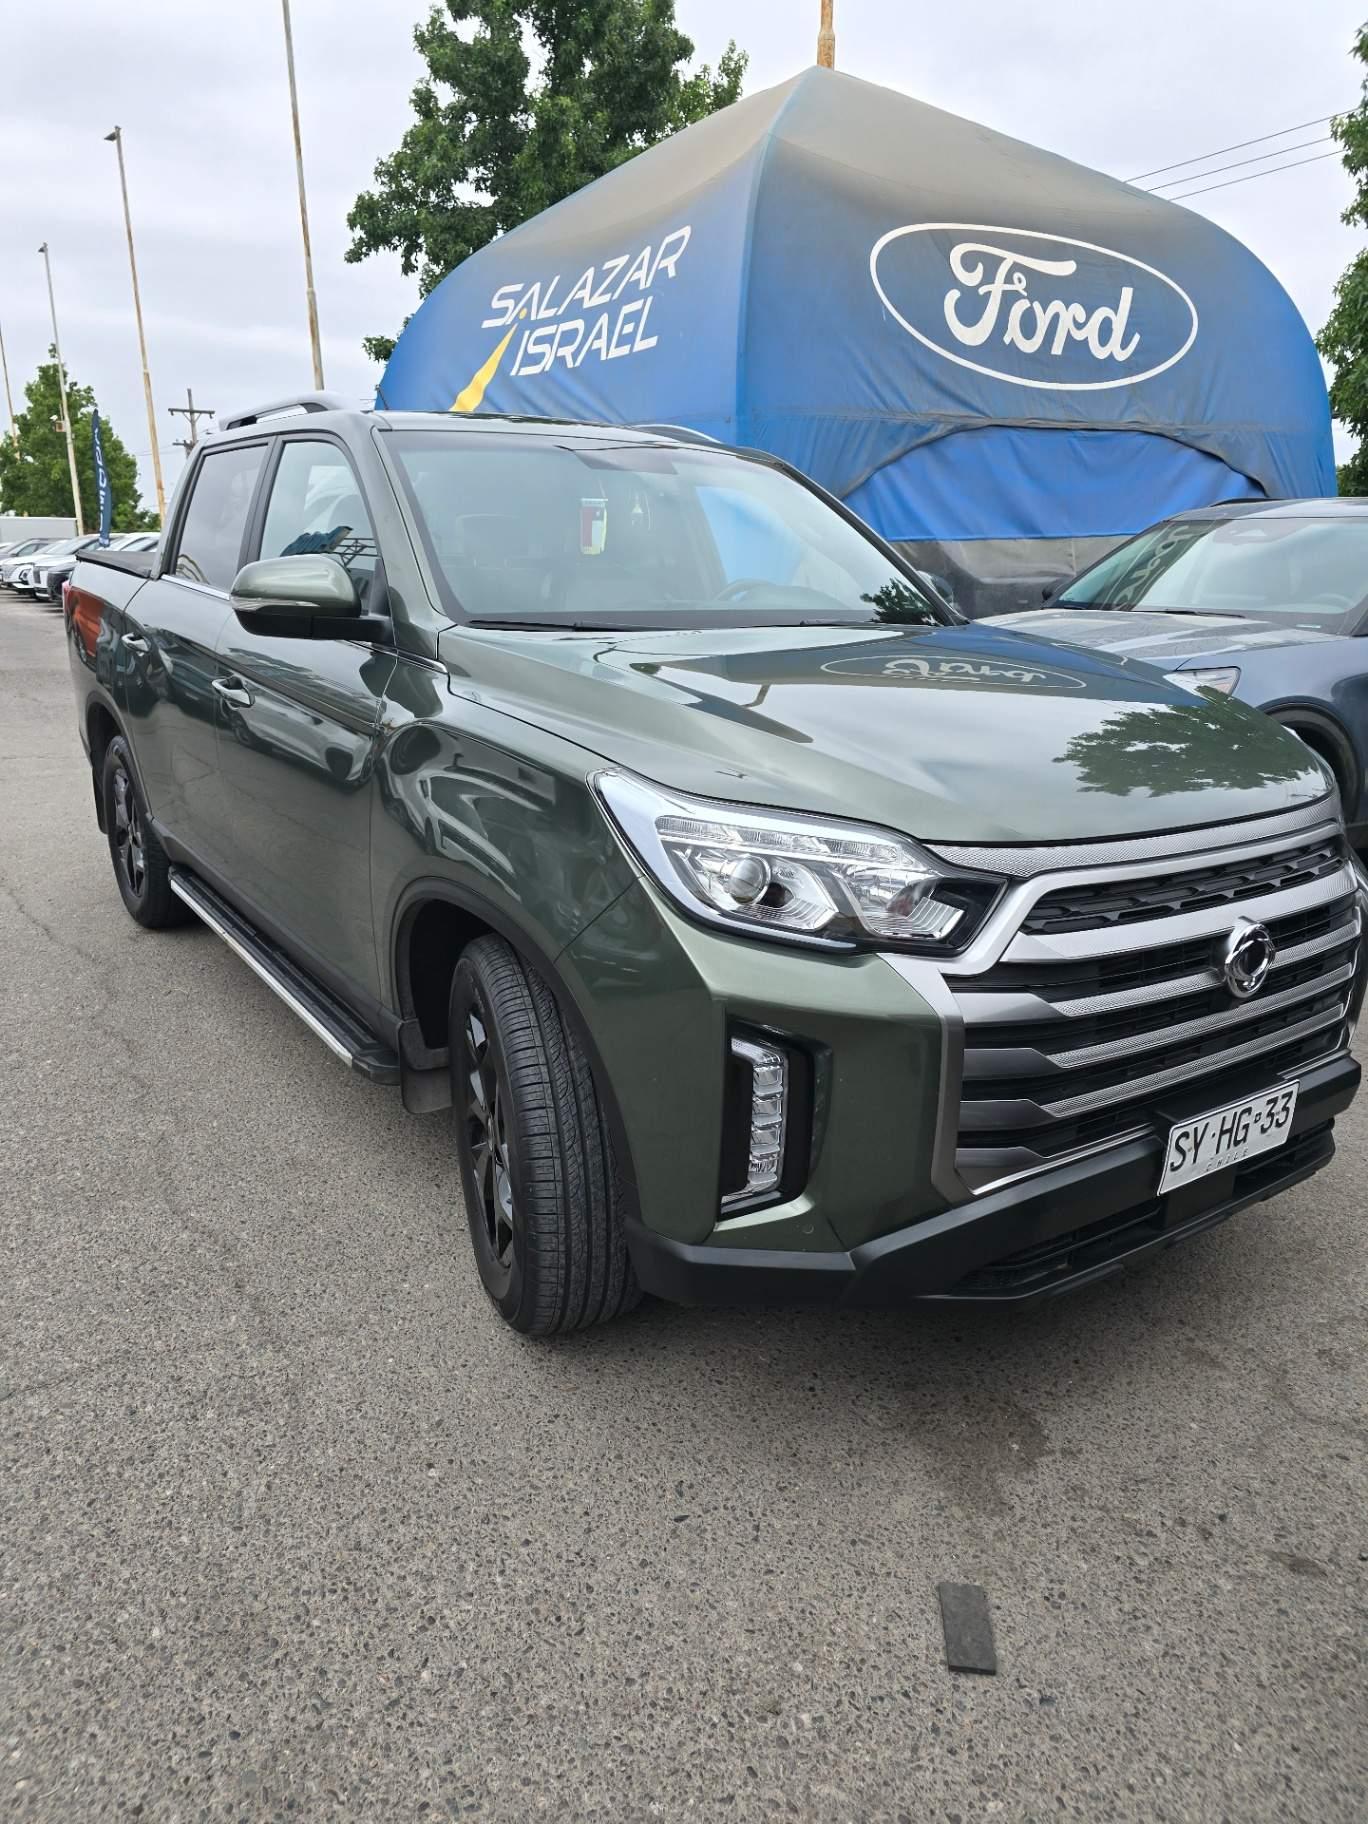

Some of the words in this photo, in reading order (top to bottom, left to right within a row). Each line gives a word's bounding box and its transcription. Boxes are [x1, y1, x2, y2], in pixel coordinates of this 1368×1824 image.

[481, 225, 692, 329] SALAZAR
[943, 242, 1141, 362] Ford
[509, 295, 659, 376] ISRAEL
[1206, 1148, 1249, 1172] CHILE
